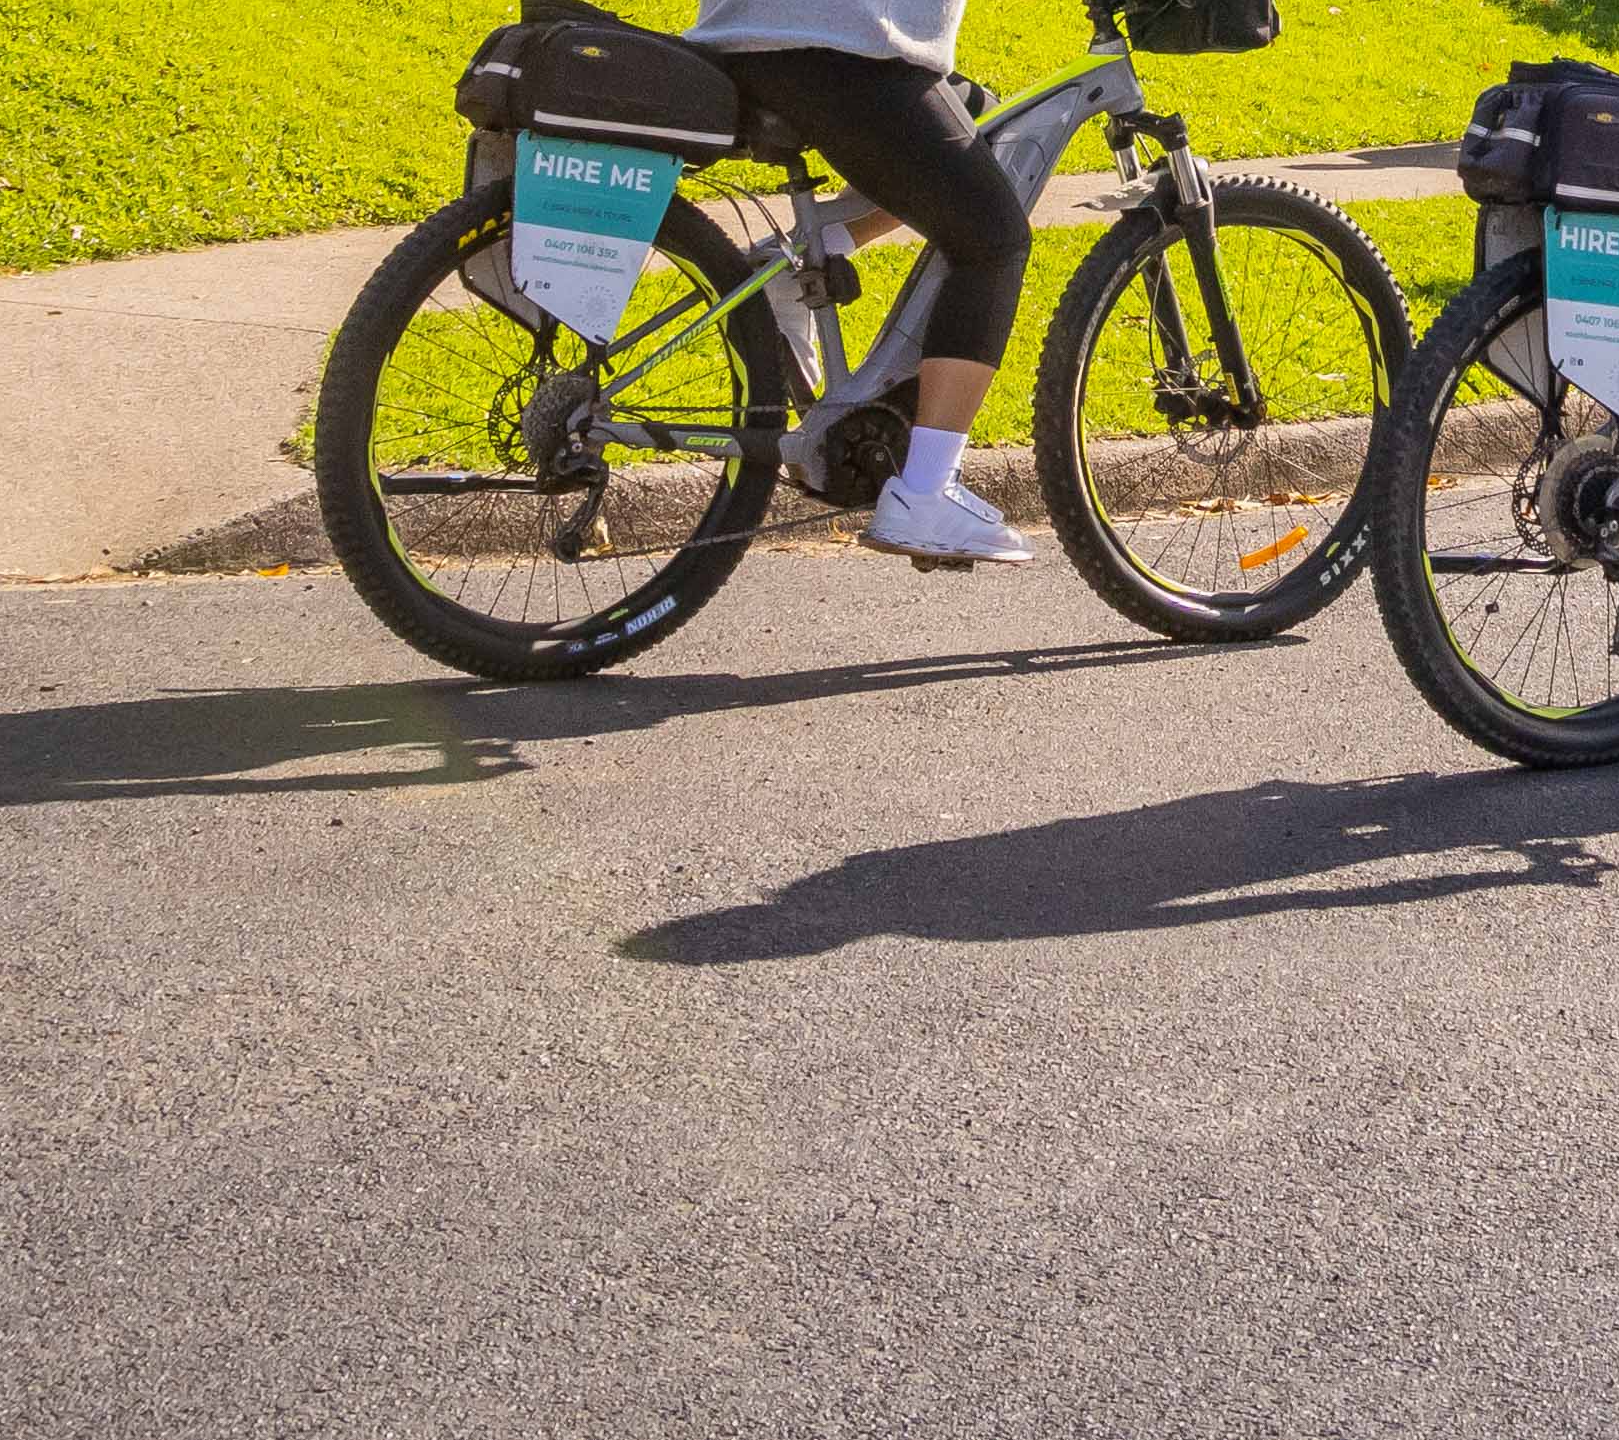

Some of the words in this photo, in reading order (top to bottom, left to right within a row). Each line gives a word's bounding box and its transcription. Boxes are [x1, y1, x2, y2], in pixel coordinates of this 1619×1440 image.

[533, 150, 603, 184] HIRE
[610, 164, 653, 193] ME
[544, 238, 573, 252] 0407
[1560, 225, 1619, 256] HIRE
[1575, 313, 1600, 326] 0407
